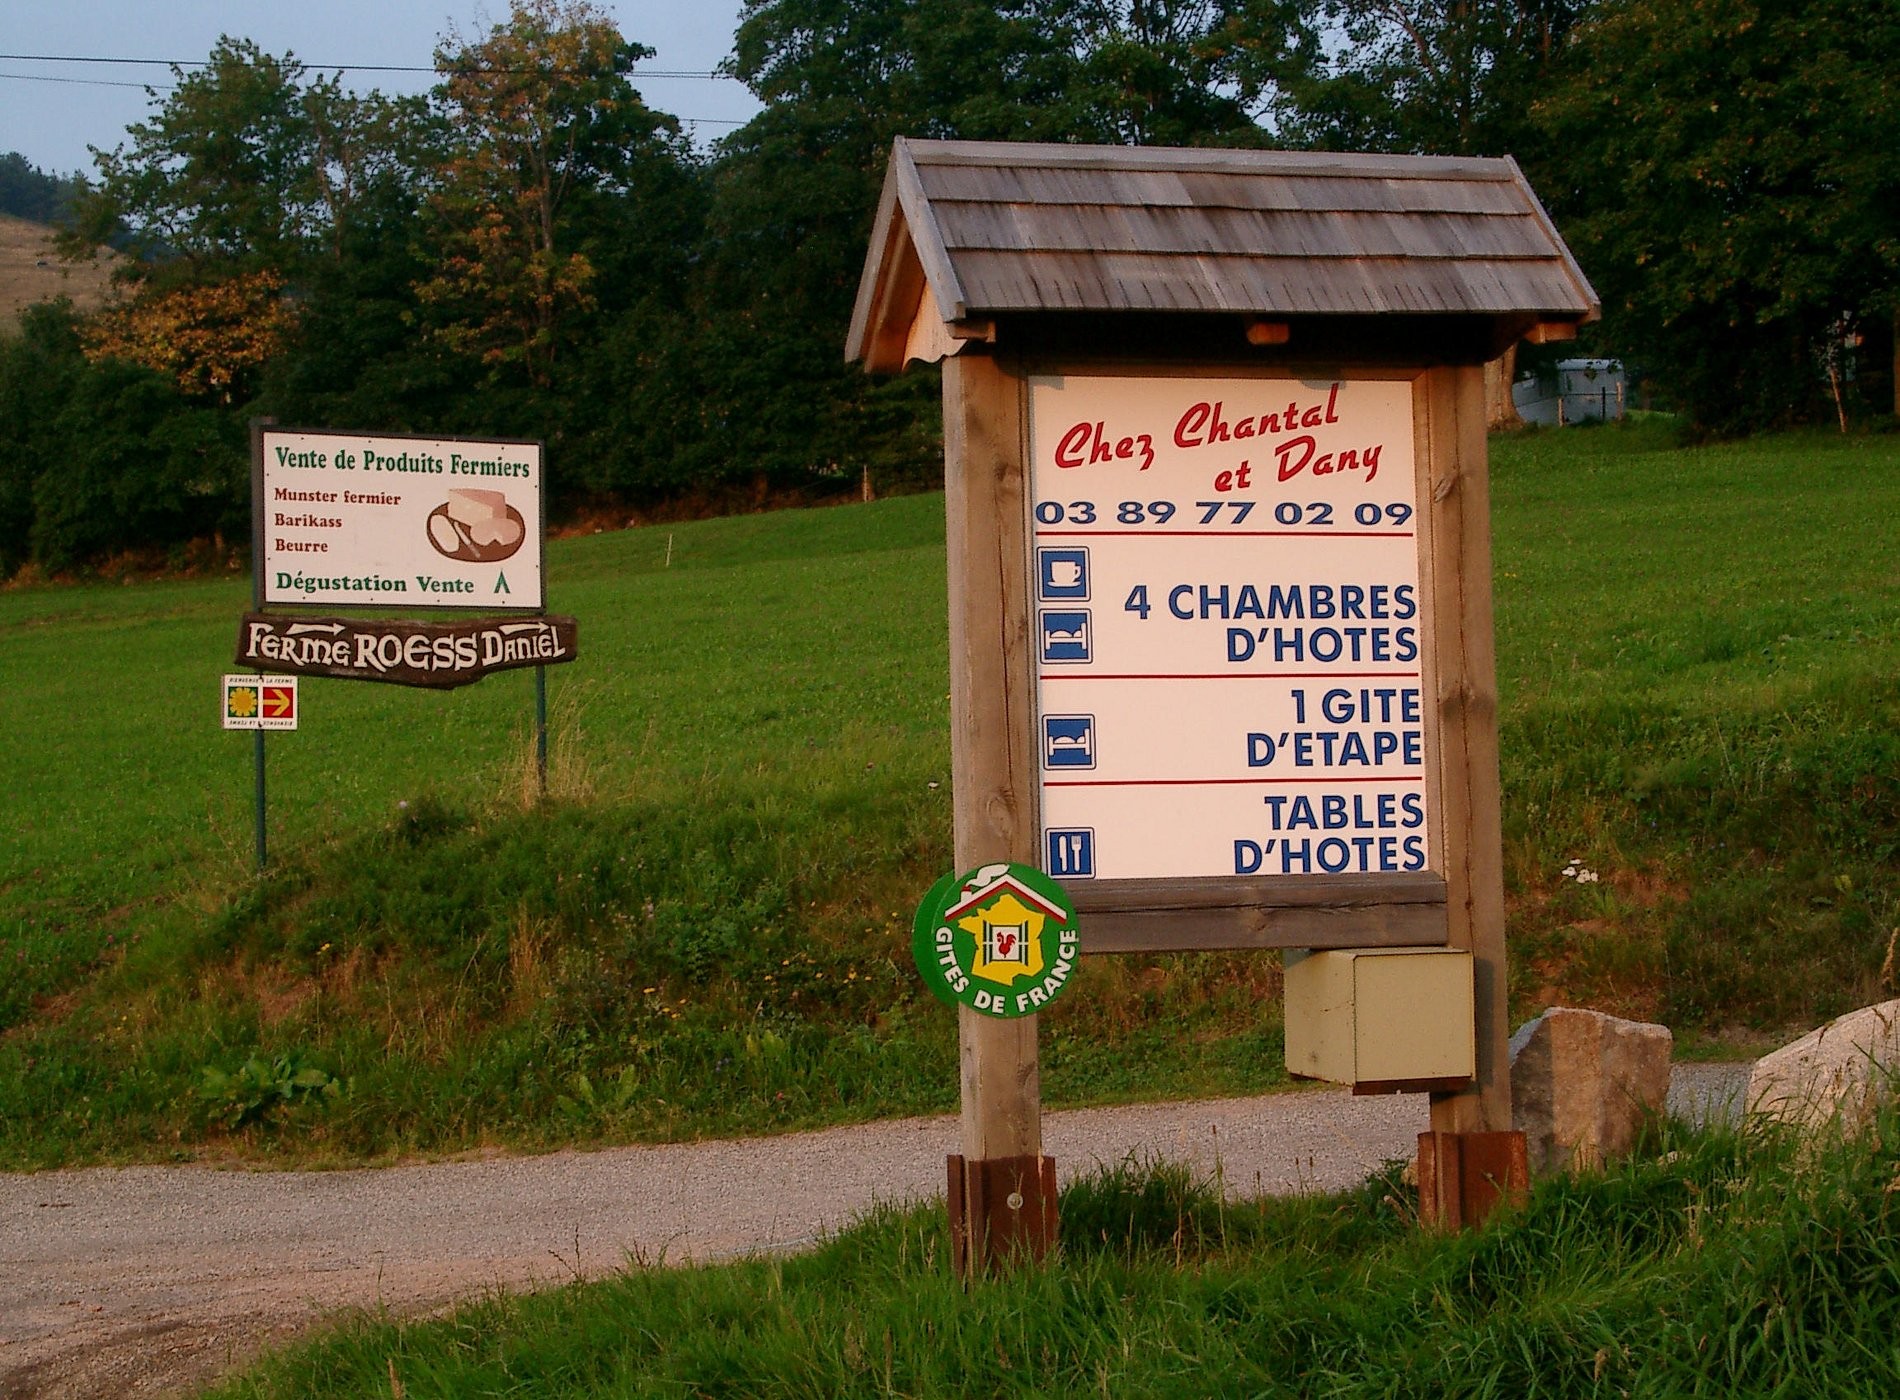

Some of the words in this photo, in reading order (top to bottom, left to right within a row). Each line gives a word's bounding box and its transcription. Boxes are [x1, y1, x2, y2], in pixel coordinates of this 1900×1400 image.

[1055, 421, 1154, 470] Chez
[1173, 383, 1339, 448] Chantal
[275, 446, 327, 469] Vente
[334, 449, 356, 470] de
[363, 450, 443, 474] Produits
[450, 454, 530, 478] Fermiers
[1214, 460, 1251, 492] et
[1274, 435, 1383, 482] Dany
[274, 487, 338, 503] Munster
[343, 490, 402, 505] fermier
[1036, 501, 1097, 525] 03
[1117, 501, 1176, 525] 89
[1195, 501, 1257, 525] 77
[1274, 502, 1334, 525] 02
[1354, 502, 1413, 526] 09
[274, 513, 342, 528] Barikass
[275, 538, 329, 553] Beurre
[276, 570, 408, 594] Dégustation
[416, 576, 475, 593] Vente
[1124, 585, 1151, 620] 4
[1168, 584, 1416, 620] CHAMBRES
[353, 631, 478, 673] ROESS
[1226, 626, 1418, 663] D'HOTES
[1291, 689, 1306, 724] 1
[1322, 688, 1420, 724] GITE
[1246, 731, 1422, 768] D'ETAPE
[1264, 793, 1424, 830] TABLES
[1234, 835, 1425, 875] D'HOTES
[935, 926, 970, 994] GITES
[973, 989, 1005, 1014] DE
[1016, 930, 1077, 1012] FRANCE
